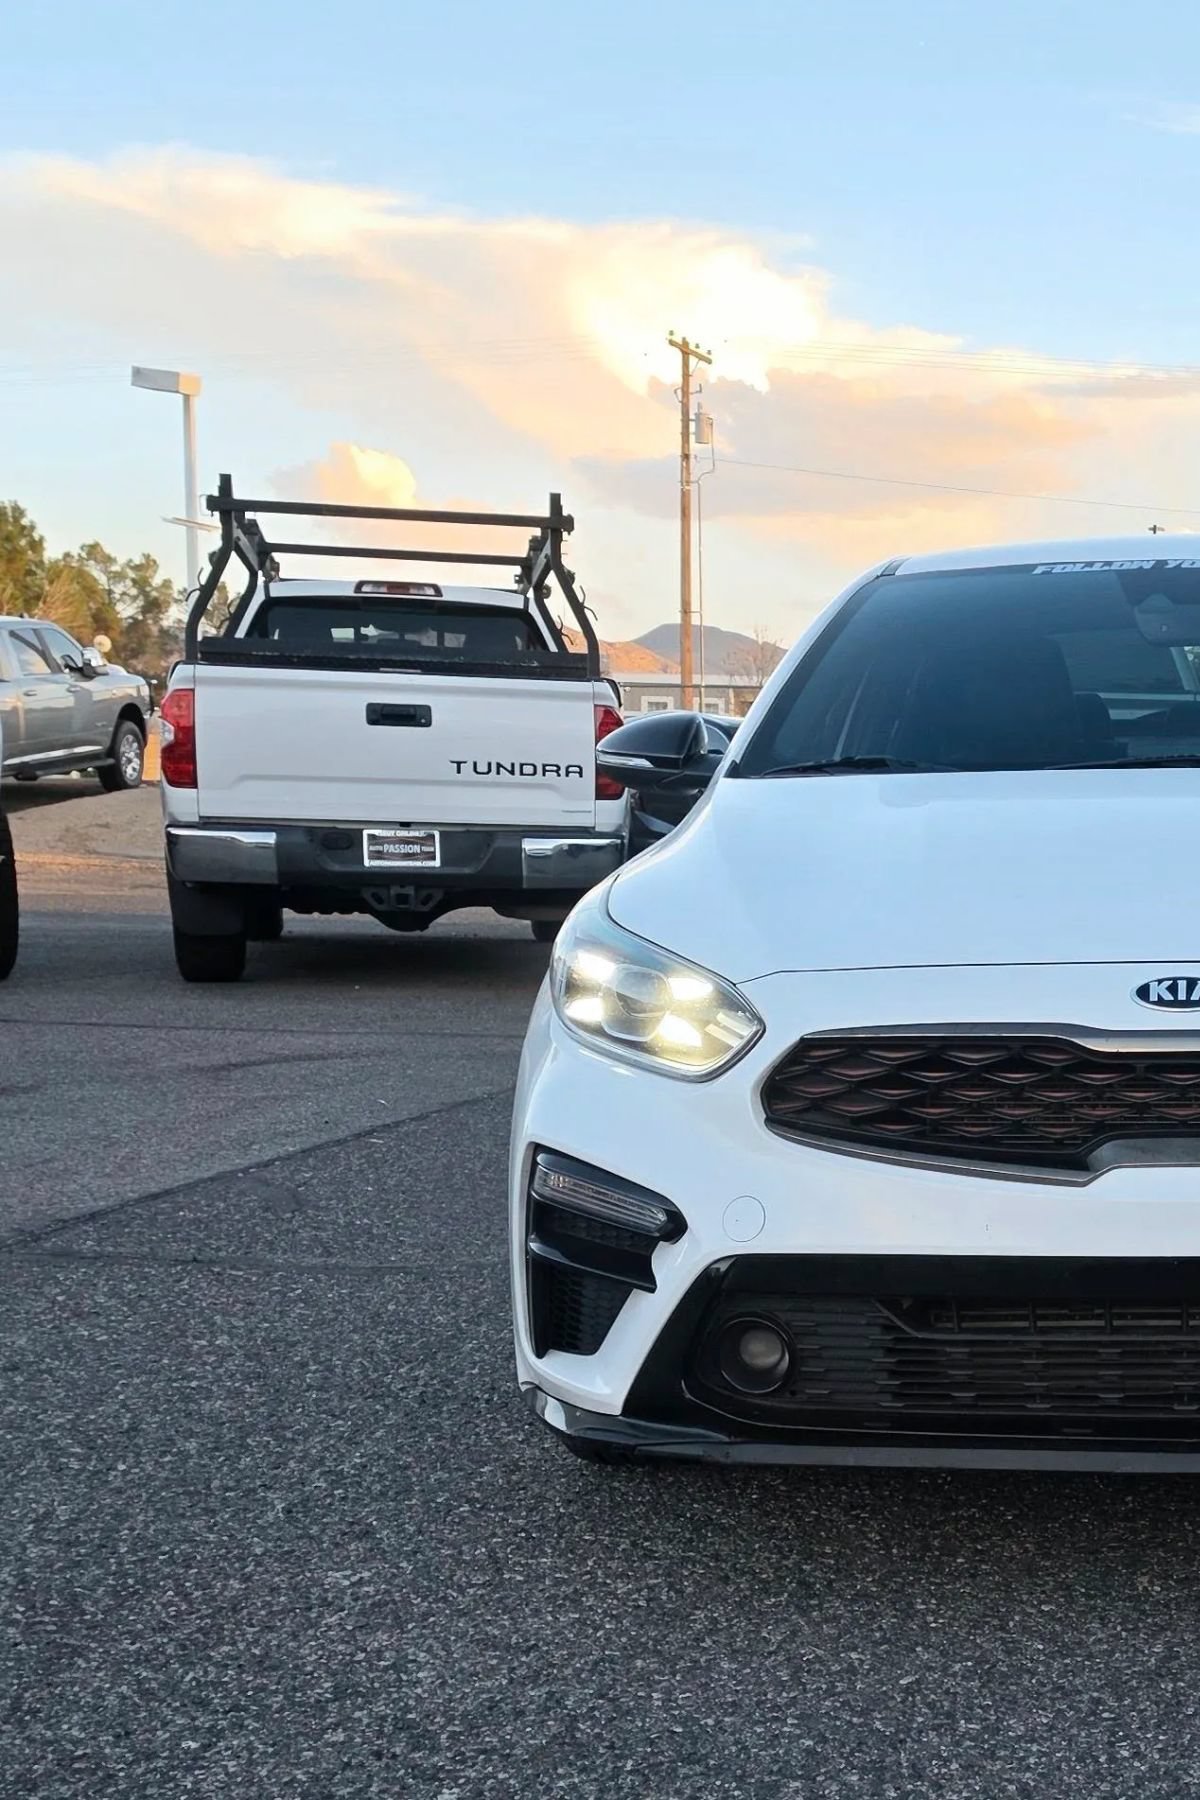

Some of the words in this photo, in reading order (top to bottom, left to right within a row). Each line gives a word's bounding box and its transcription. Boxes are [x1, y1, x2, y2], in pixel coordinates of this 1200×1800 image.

[1032, 560, 1156, 575] FOLLOW
[449, 760, 584, 778] TUNDRA
[383, 843, 421, 853] PASSION
